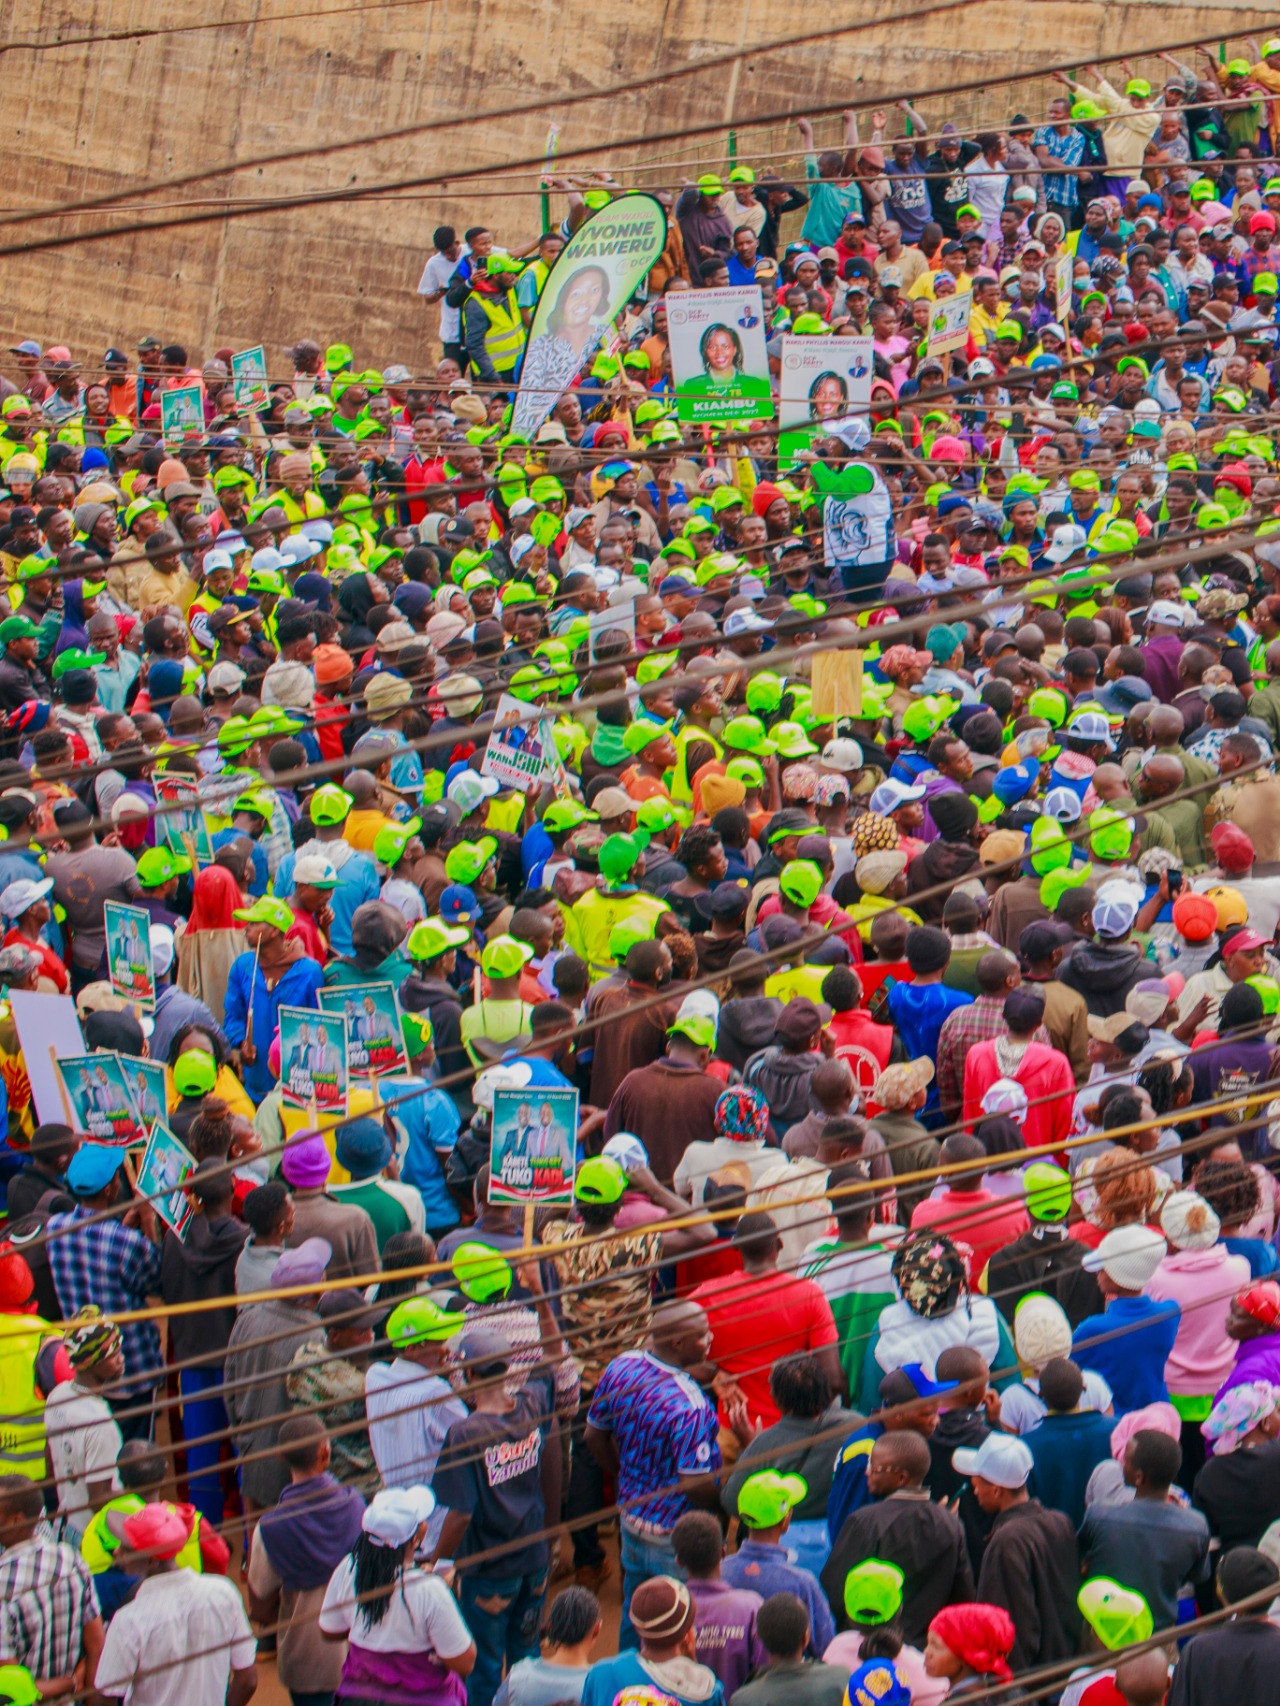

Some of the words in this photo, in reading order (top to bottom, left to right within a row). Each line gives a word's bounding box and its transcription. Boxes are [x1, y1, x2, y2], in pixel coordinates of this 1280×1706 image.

[580, 221, 656, 242] YVONNE
[567, 237, 656, 259] WAWERU
[630, 256, 653, 268] DCP
[693, 399, 756, 412] KIAMBU
[289, 1078, 314, 1098] TUKO
[315, 1081, 340, 1101] KADI
[500, 1167, 533, 1186] TUKO
[533, 1167, 564, 1187] KADI
